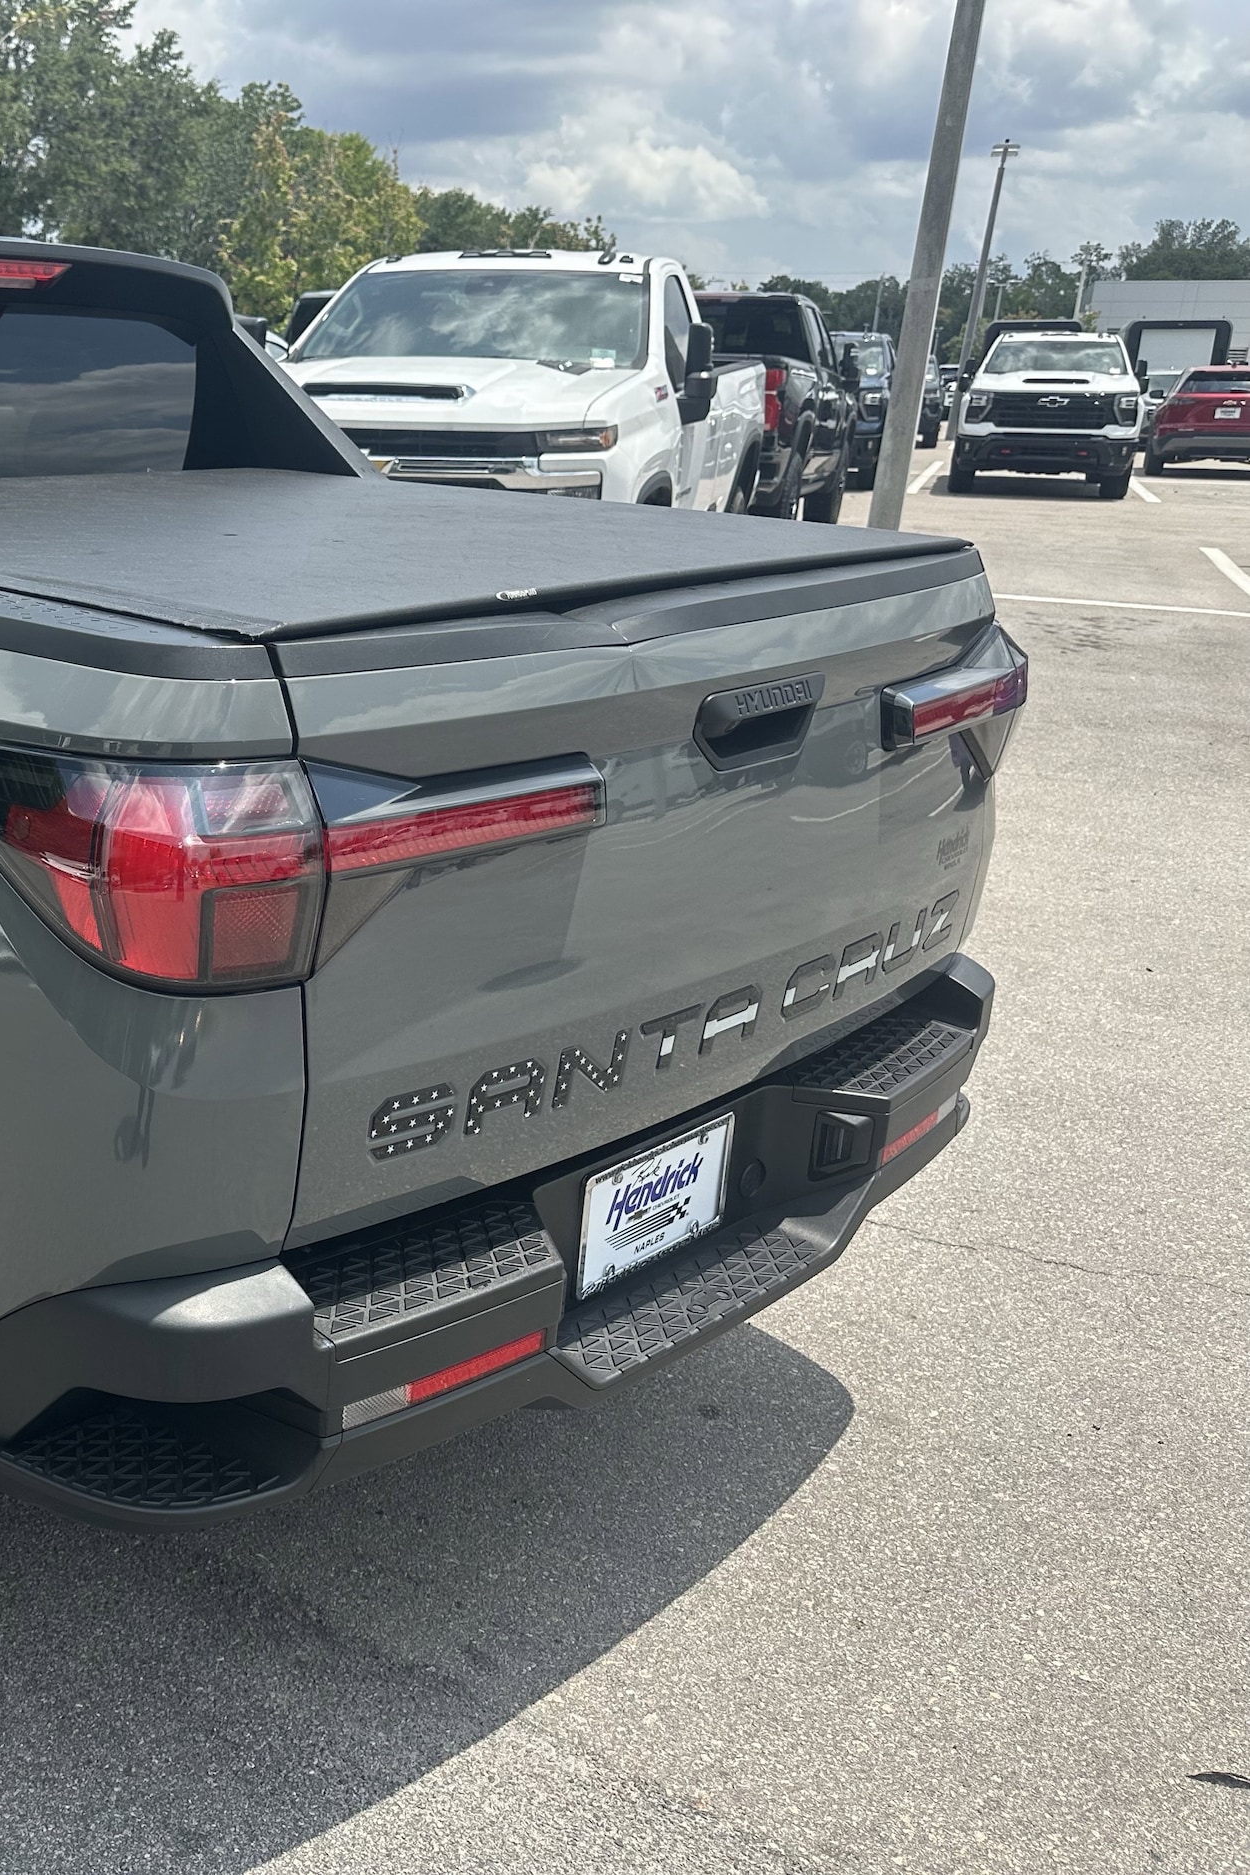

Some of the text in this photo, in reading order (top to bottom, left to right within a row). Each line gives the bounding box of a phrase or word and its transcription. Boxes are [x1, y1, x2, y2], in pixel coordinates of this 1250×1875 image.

[734, 679, 813, 717] HYUNDAI
[367, 889, 961, 1163] SANTA CRUZ
[605, 1152, 704, 1232] Hendrick
[652, 1193, 681, 1212] CHEVROLET
[633, 1231, 666, 1255] NAPLES
